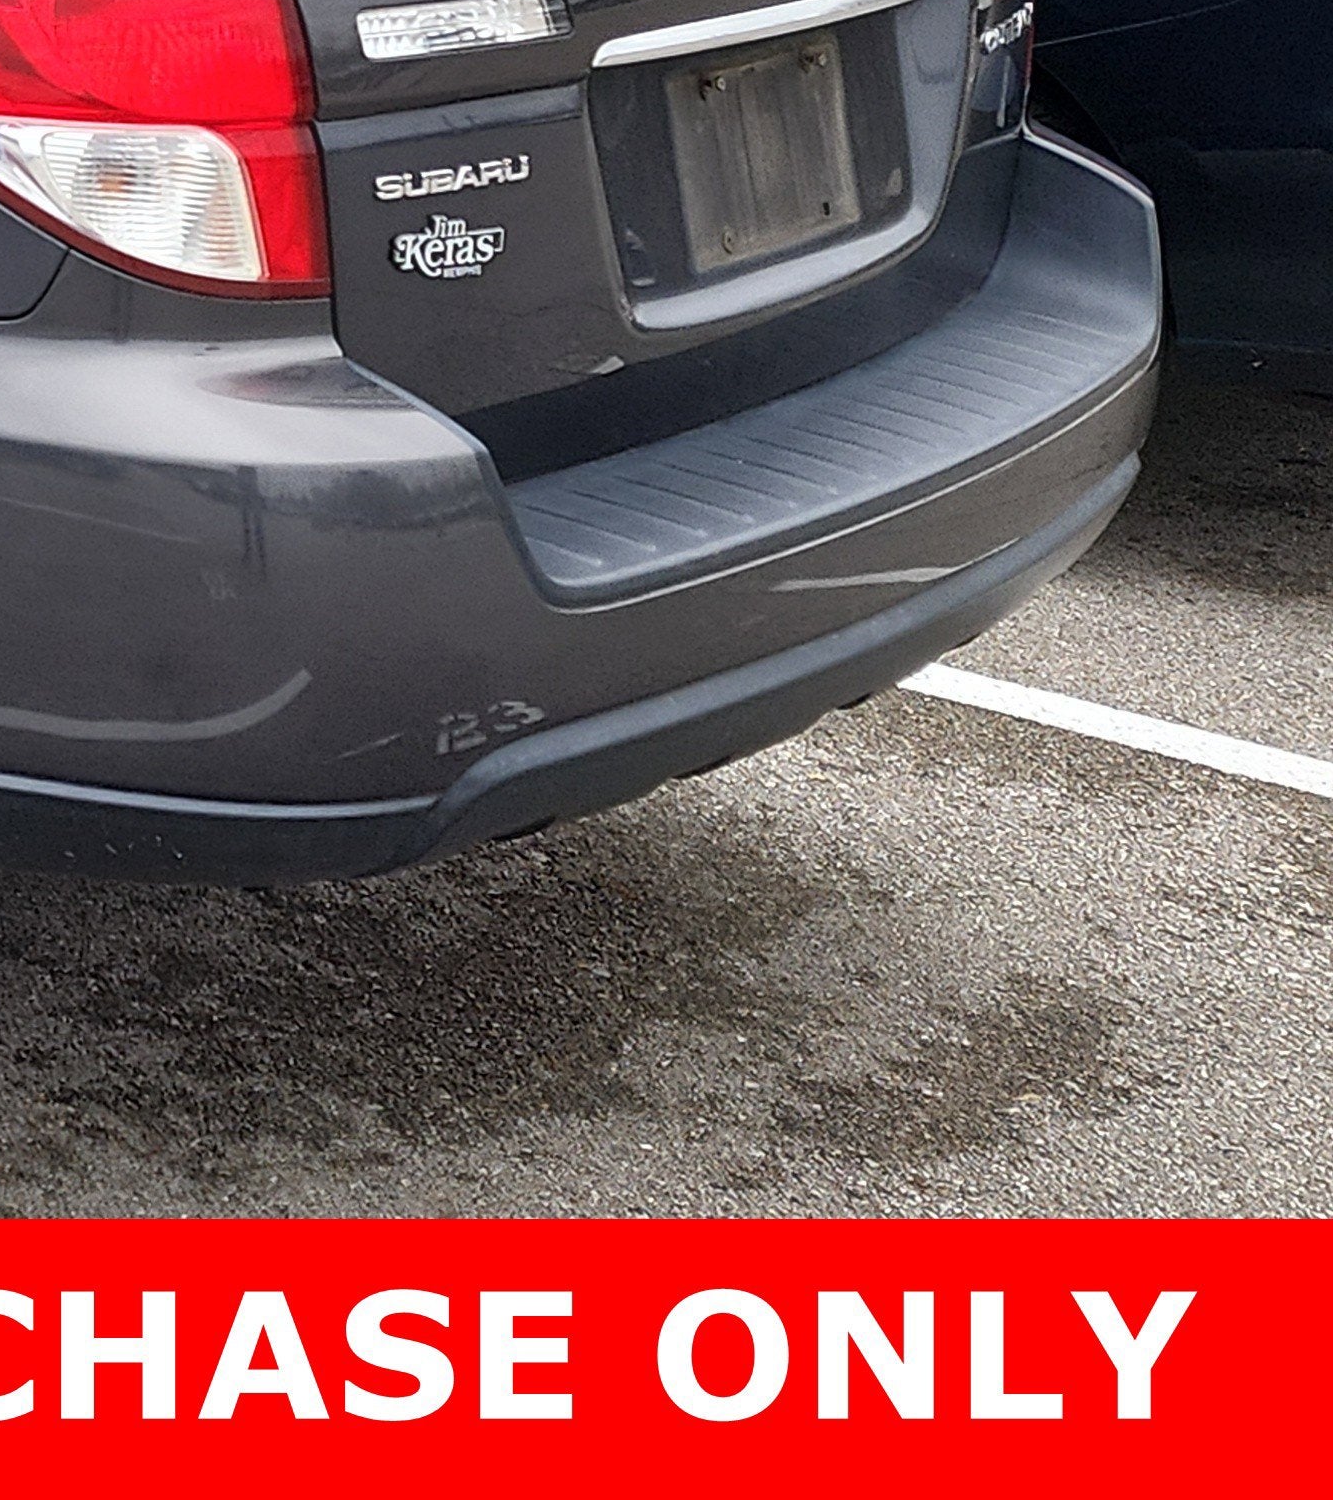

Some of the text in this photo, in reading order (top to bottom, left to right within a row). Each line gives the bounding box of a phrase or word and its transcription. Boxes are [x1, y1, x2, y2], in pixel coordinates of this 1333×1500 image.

[375, 155, 530, 200] SUBARU
[425, 214, 467, 241] Jim
[393, 233, 496, 278] Keras
